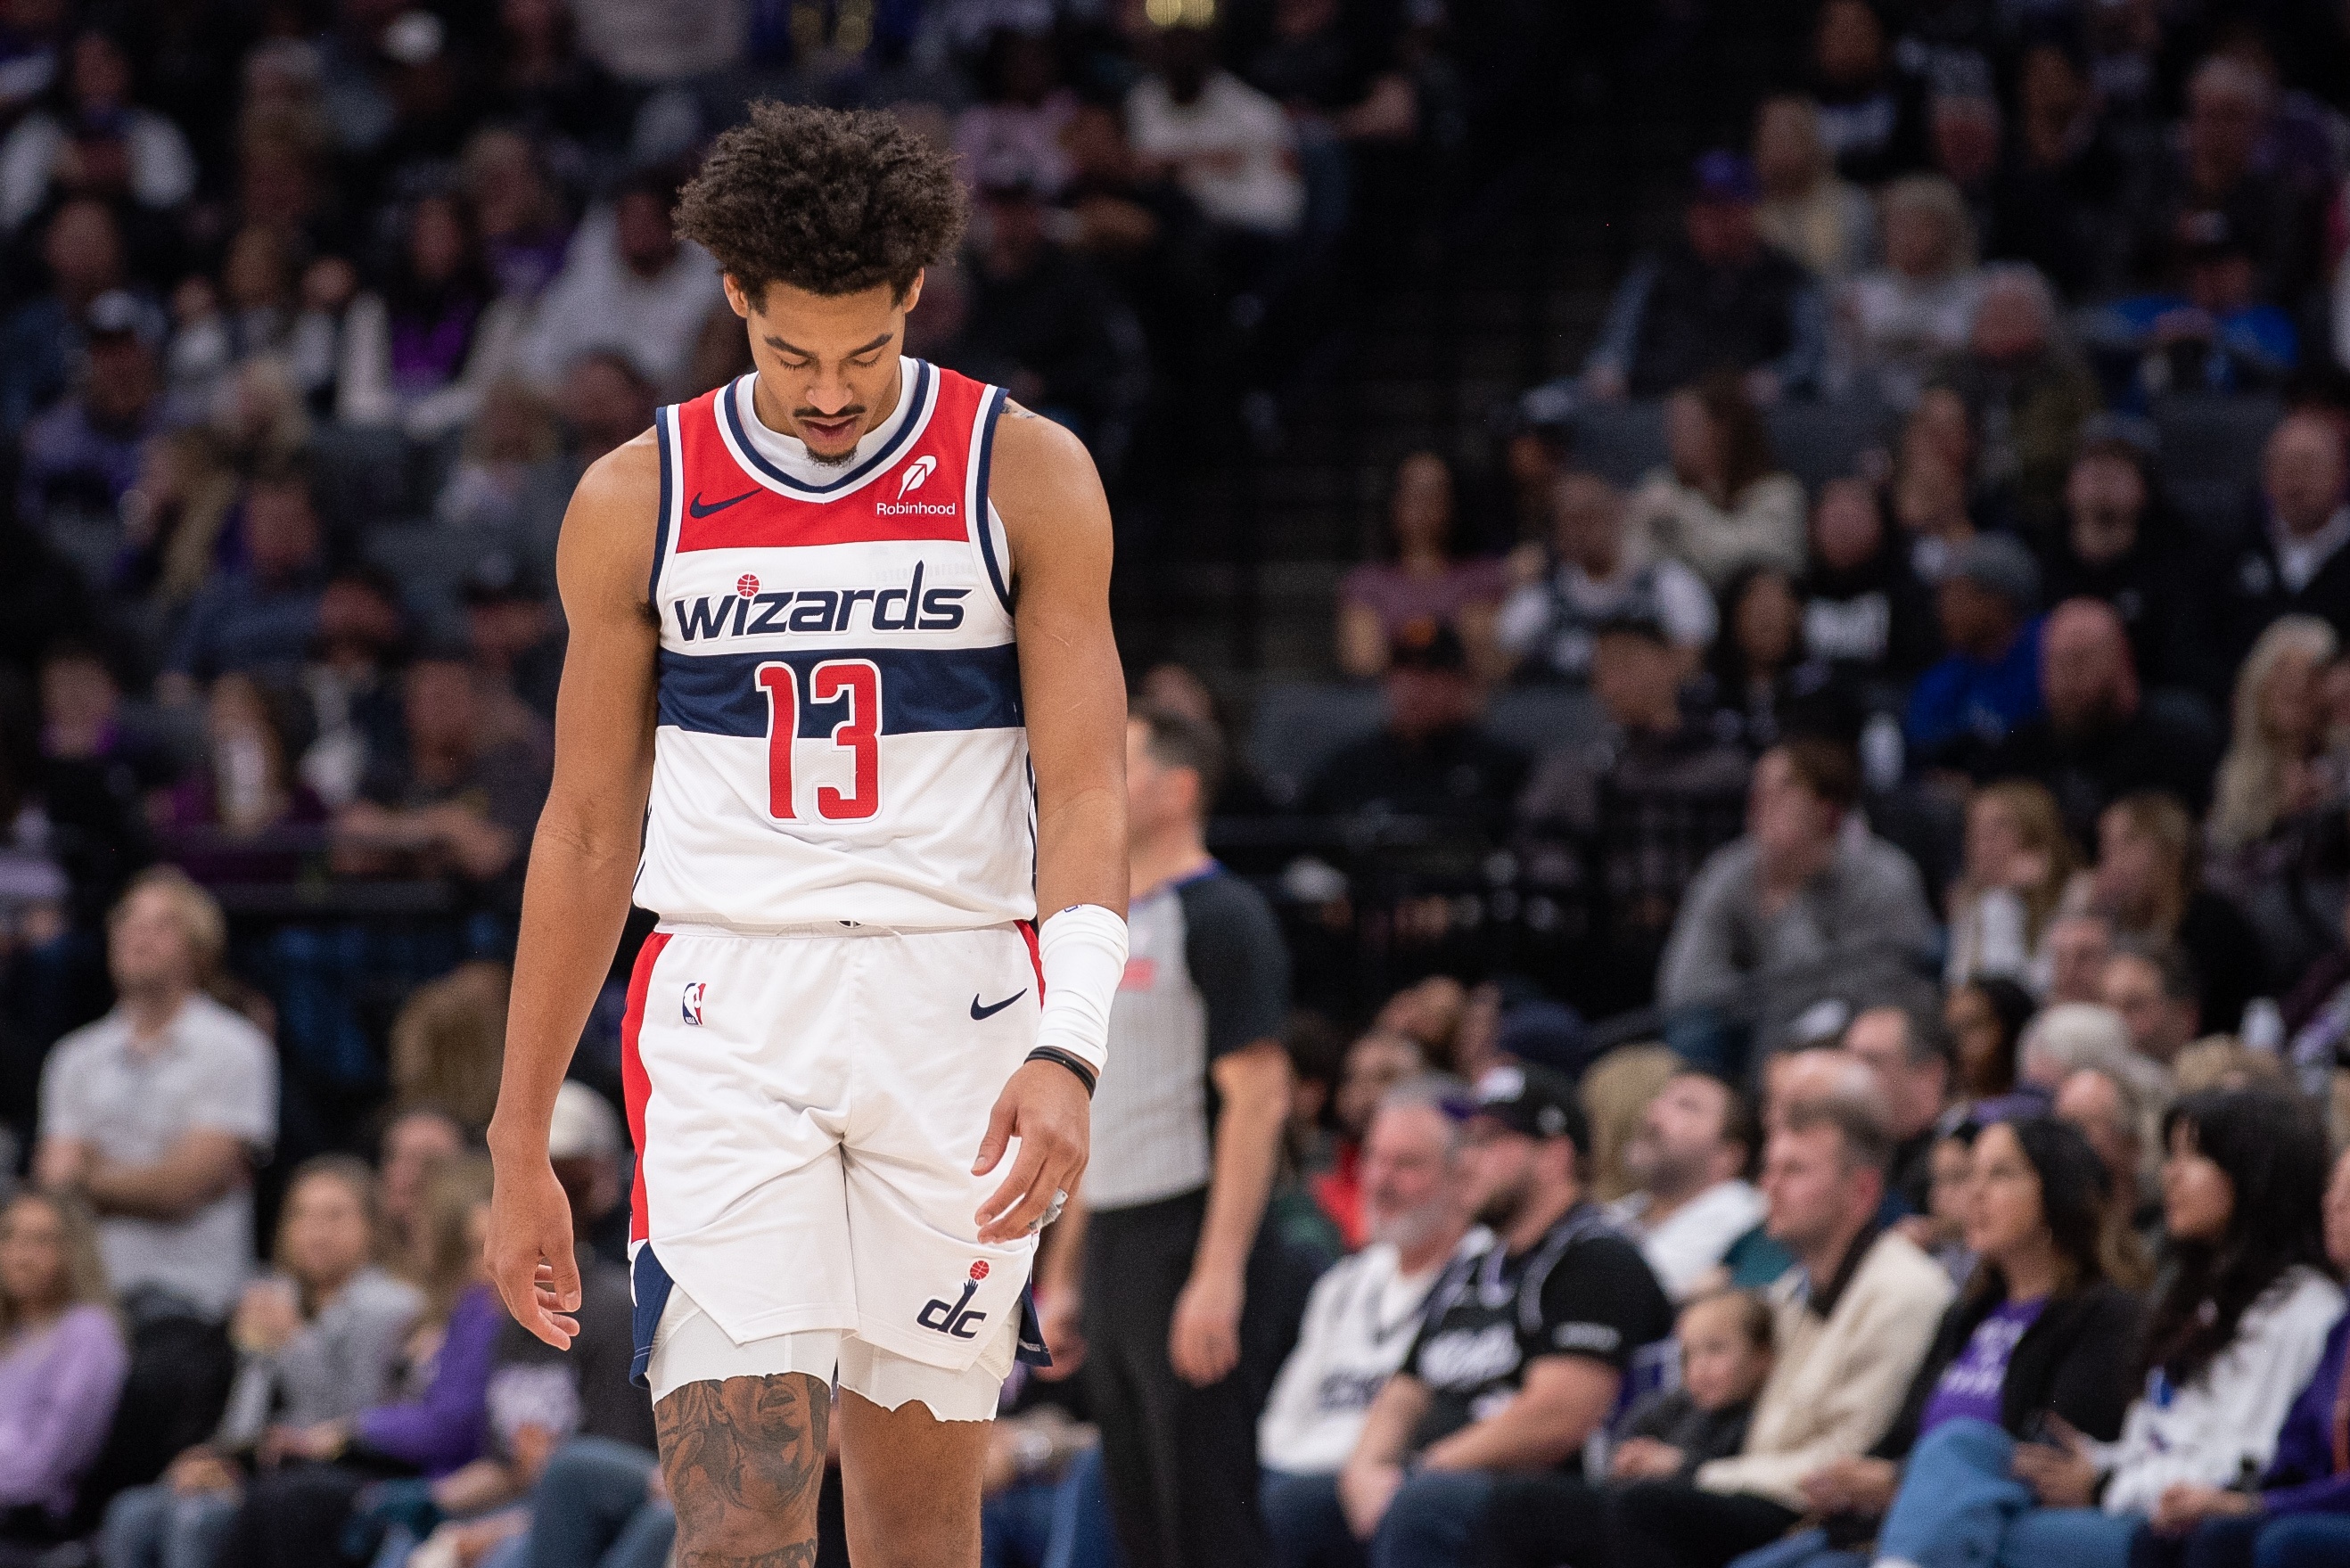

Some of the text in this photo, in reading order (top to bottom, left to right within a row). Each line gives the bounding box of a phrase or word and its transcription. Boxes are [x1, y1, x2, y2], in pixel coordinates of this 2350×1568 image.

[876, 502, 956, 516] Robinhood
[675, 560, 973, 642] wizards
[756, 660, 883, 823] 13
